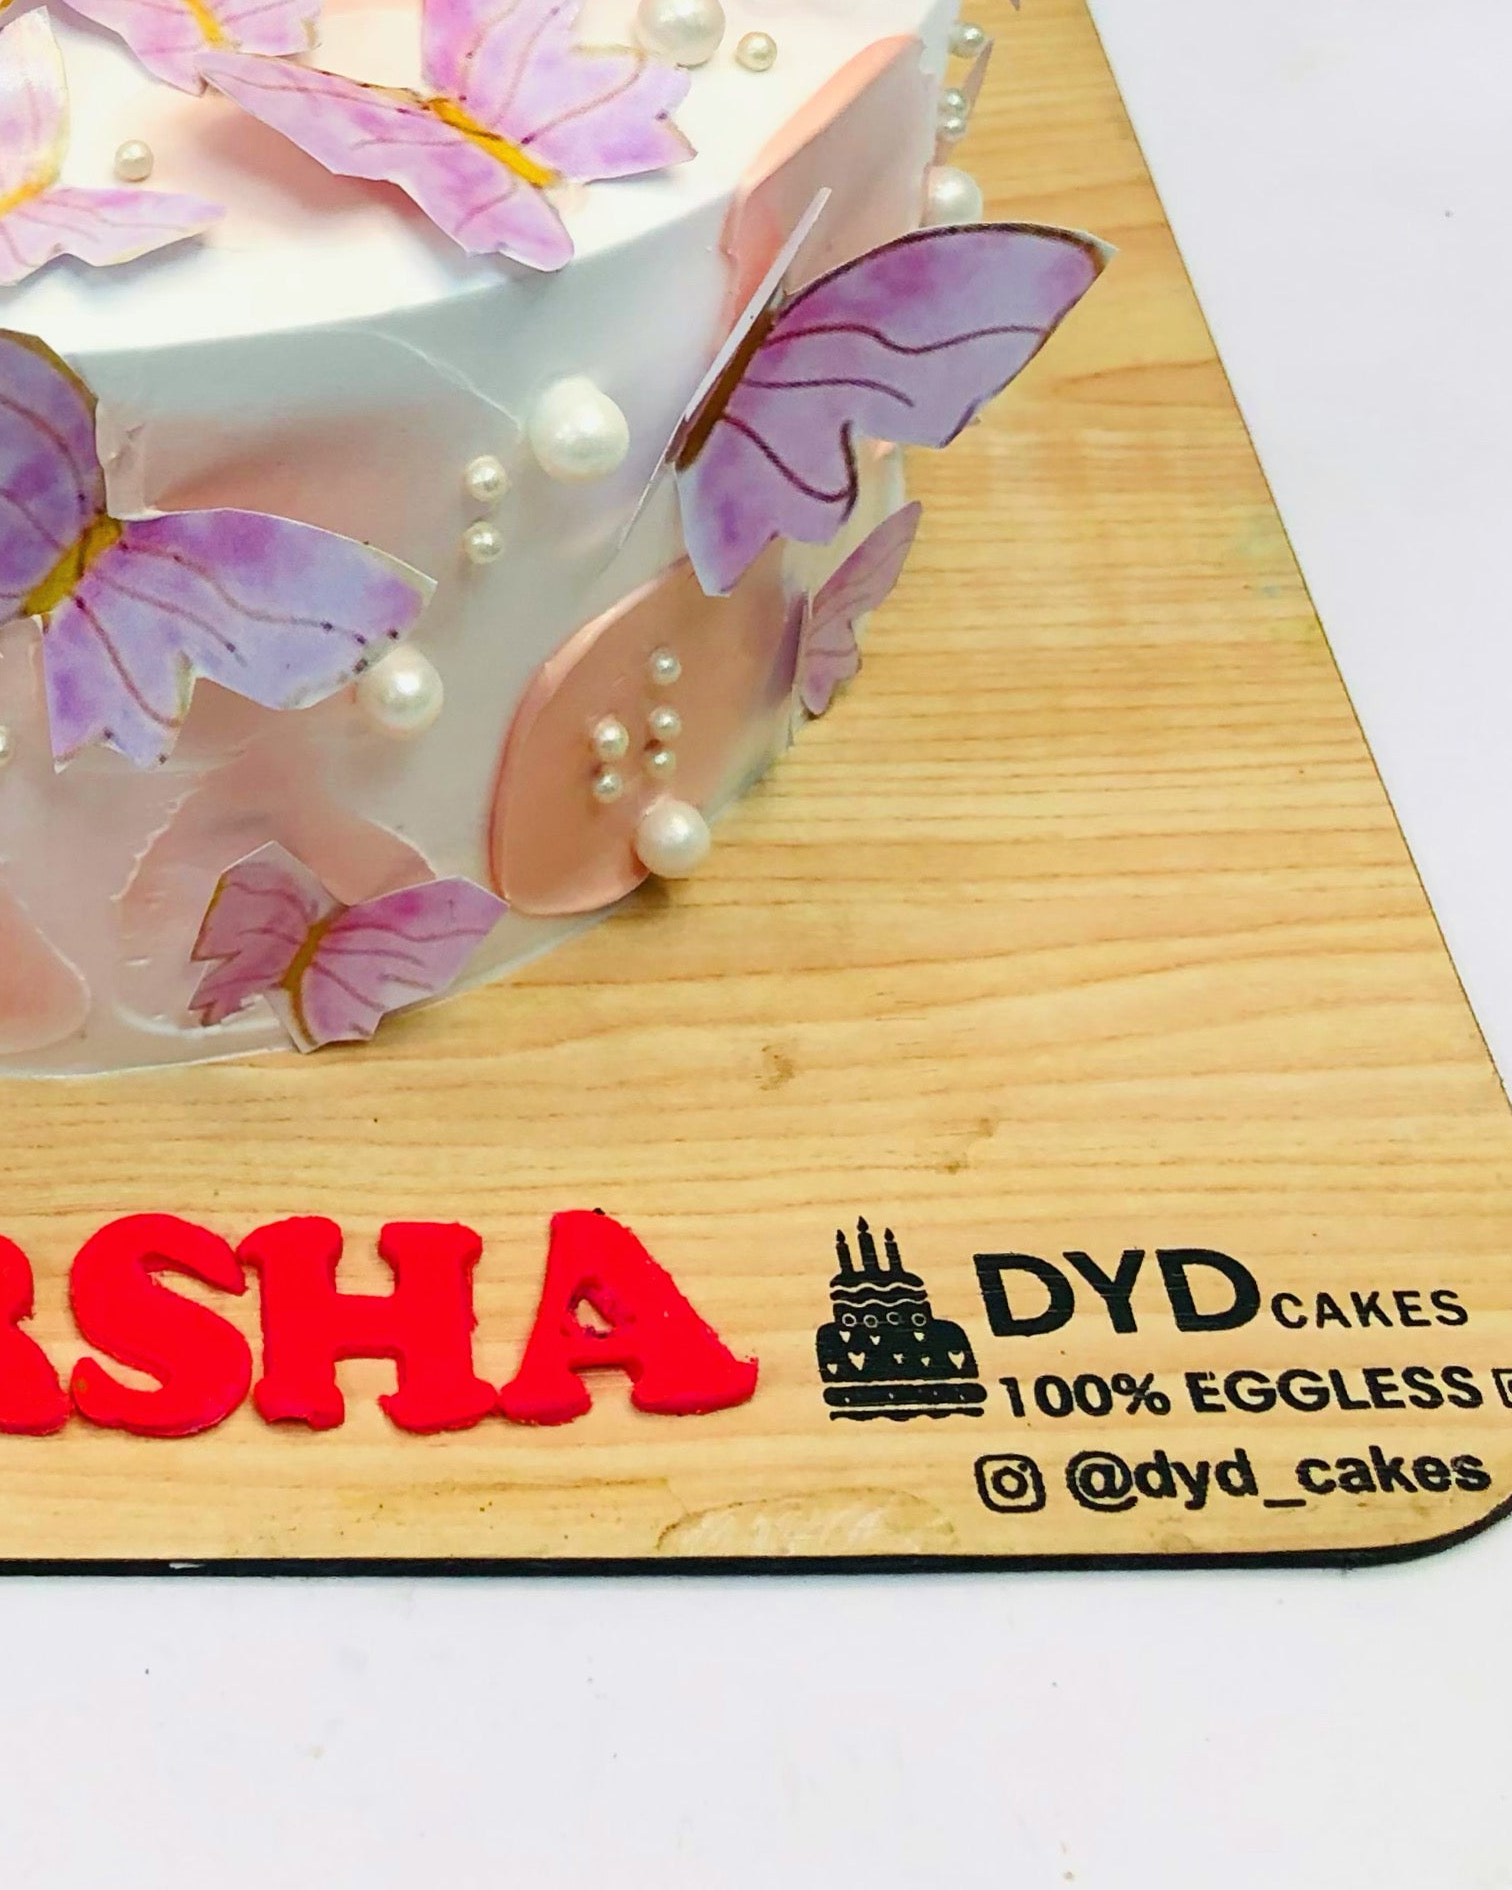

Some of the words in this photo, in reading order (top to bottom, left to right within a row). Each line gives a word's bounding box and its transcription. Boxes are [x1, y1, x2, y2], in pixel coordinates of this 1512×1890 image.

[973, 1247, 1263, 1338] DYD
[1270, 1289, 1469, 1330] CAKES
[997, 1372, 1171, 1418] 100%
[1185, 1366, 1483, 1414] EGGLESS
[1065, 1445, 1492, 1512] @dyd_cakes
